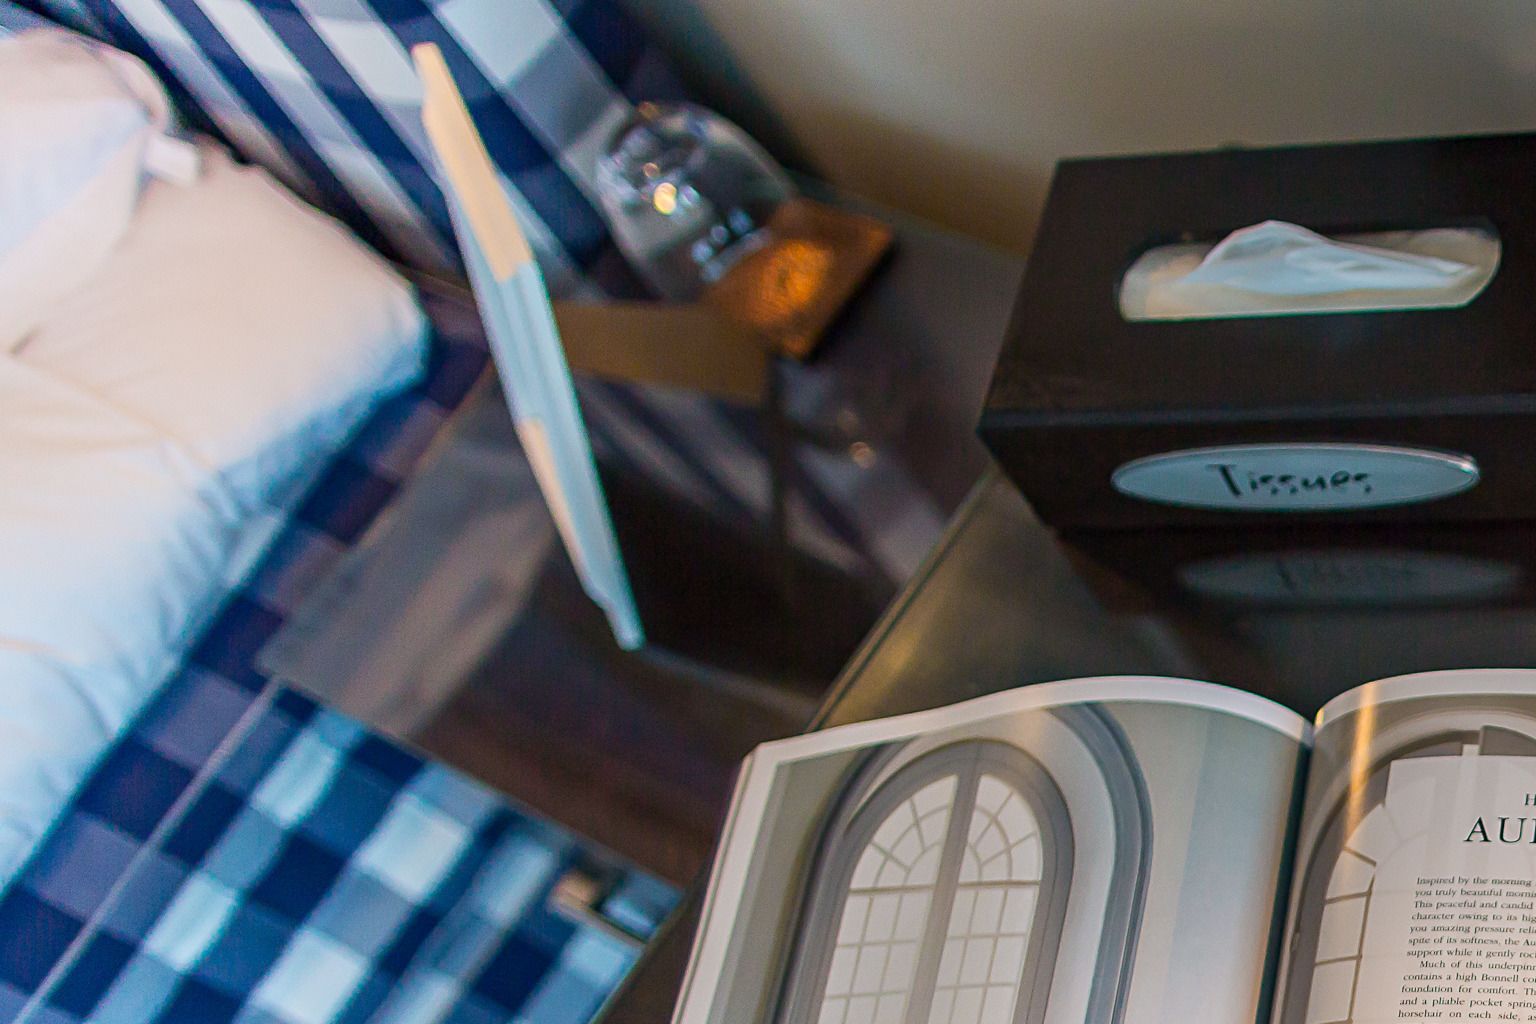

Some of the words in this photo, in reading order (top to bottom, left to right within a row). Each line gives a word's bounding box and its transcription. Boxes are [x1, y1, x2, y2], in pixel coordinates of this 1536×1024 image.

[1416, 876, 1454, 886] Inspired
[1457, 877, 1469, 886] by
[1434, 888, 1456, 898] truly
[1459, 888, 1502, 896] beautiful
[1435, 900, 1476, 910] peaceful
[1500, 901, 1533, 909] candid
[1411, 912, 1454, 920] character
[1457, 913, 1488, 922] owing
[1430, 925, 1470, 934] amazing
[1473, 926, 1514, 935] pressure
[1433, 936, 1443, 944] of
[1504, 937, 1520, 945] the
[1406, 949, 1442, 958] support
[1485, 949, 1515, 959] gently
[1419, 960, 1446, 968] Much
[1465, 961, 1483, 969] this
[1455, 973, 1477, 983] high
[1480, 974, 1518, 982] Bonnell
[1401, 985, 1453, 993] foundation
[1431, 998, 1465, 1008] pliable
[1469, 998, 1502, 1008] pocket
[1397, 1010, 1442, 1018] horsehair
[1468, 1011, 1491, 1019] each
